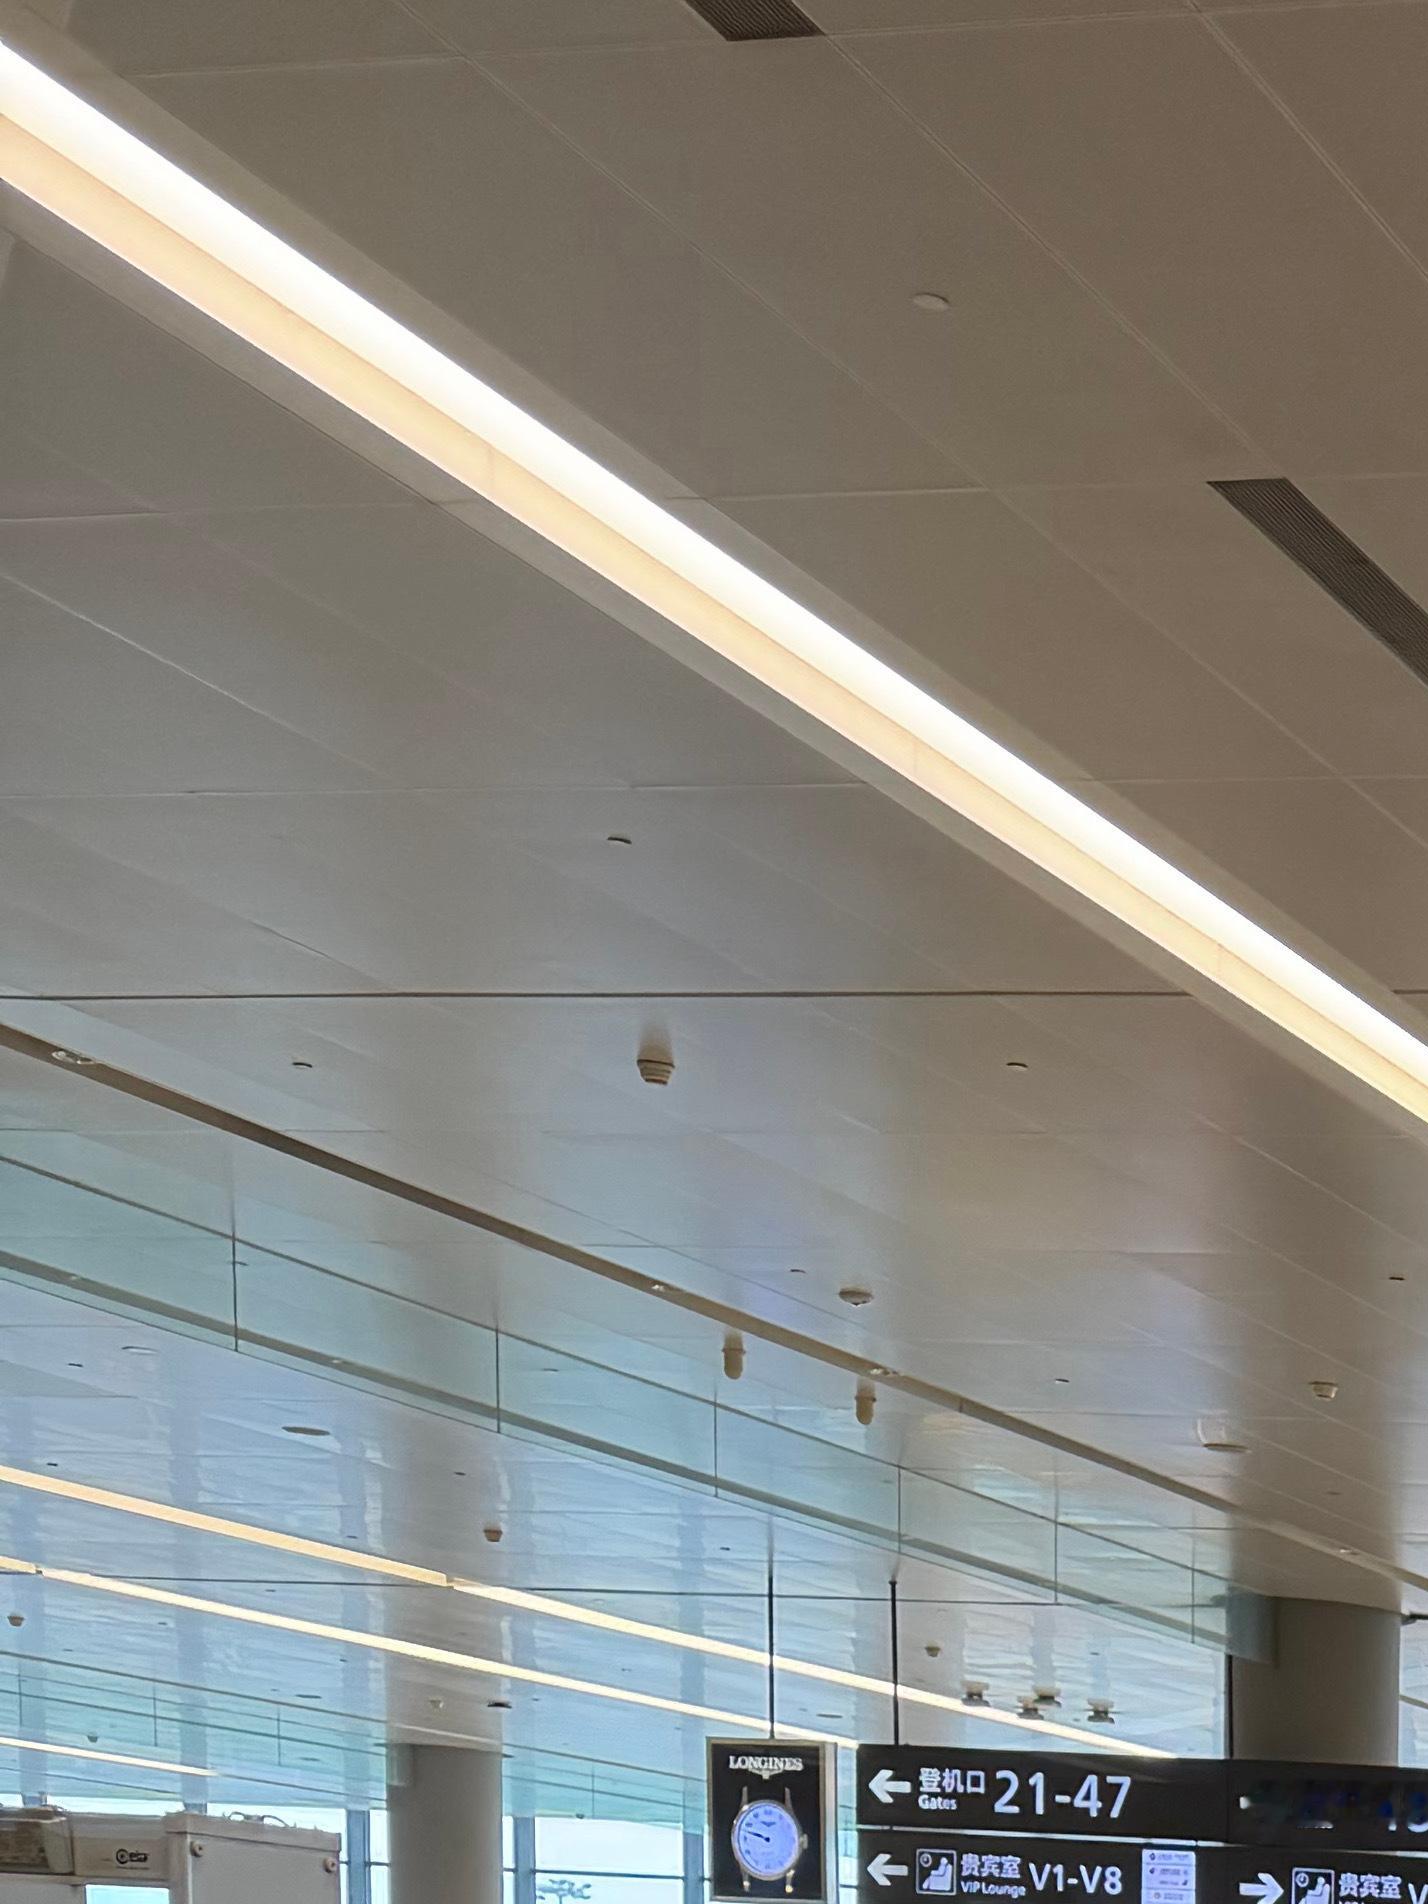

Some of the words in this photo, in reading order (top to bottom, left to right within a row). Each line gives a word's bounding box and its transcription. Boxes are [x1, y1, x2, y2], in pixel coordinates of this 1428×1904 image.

[728, 1755, 803, 1772] LONGINES
[918, 1767, 986, 1793] 登机口
[918, 1794, 957, 1811] Gates
[993, 1770, 1131, 1819] 21-47
[960, 1853, 1022, 1879] 贵宾室
[1028, 1862, 1123, 1896] V1-V8
[960, 1881, 981, 1894] VIP
[982, 1883, 1026, 1898] Lounge
[1339, 1873, 1402, 1900] 贵宾室
